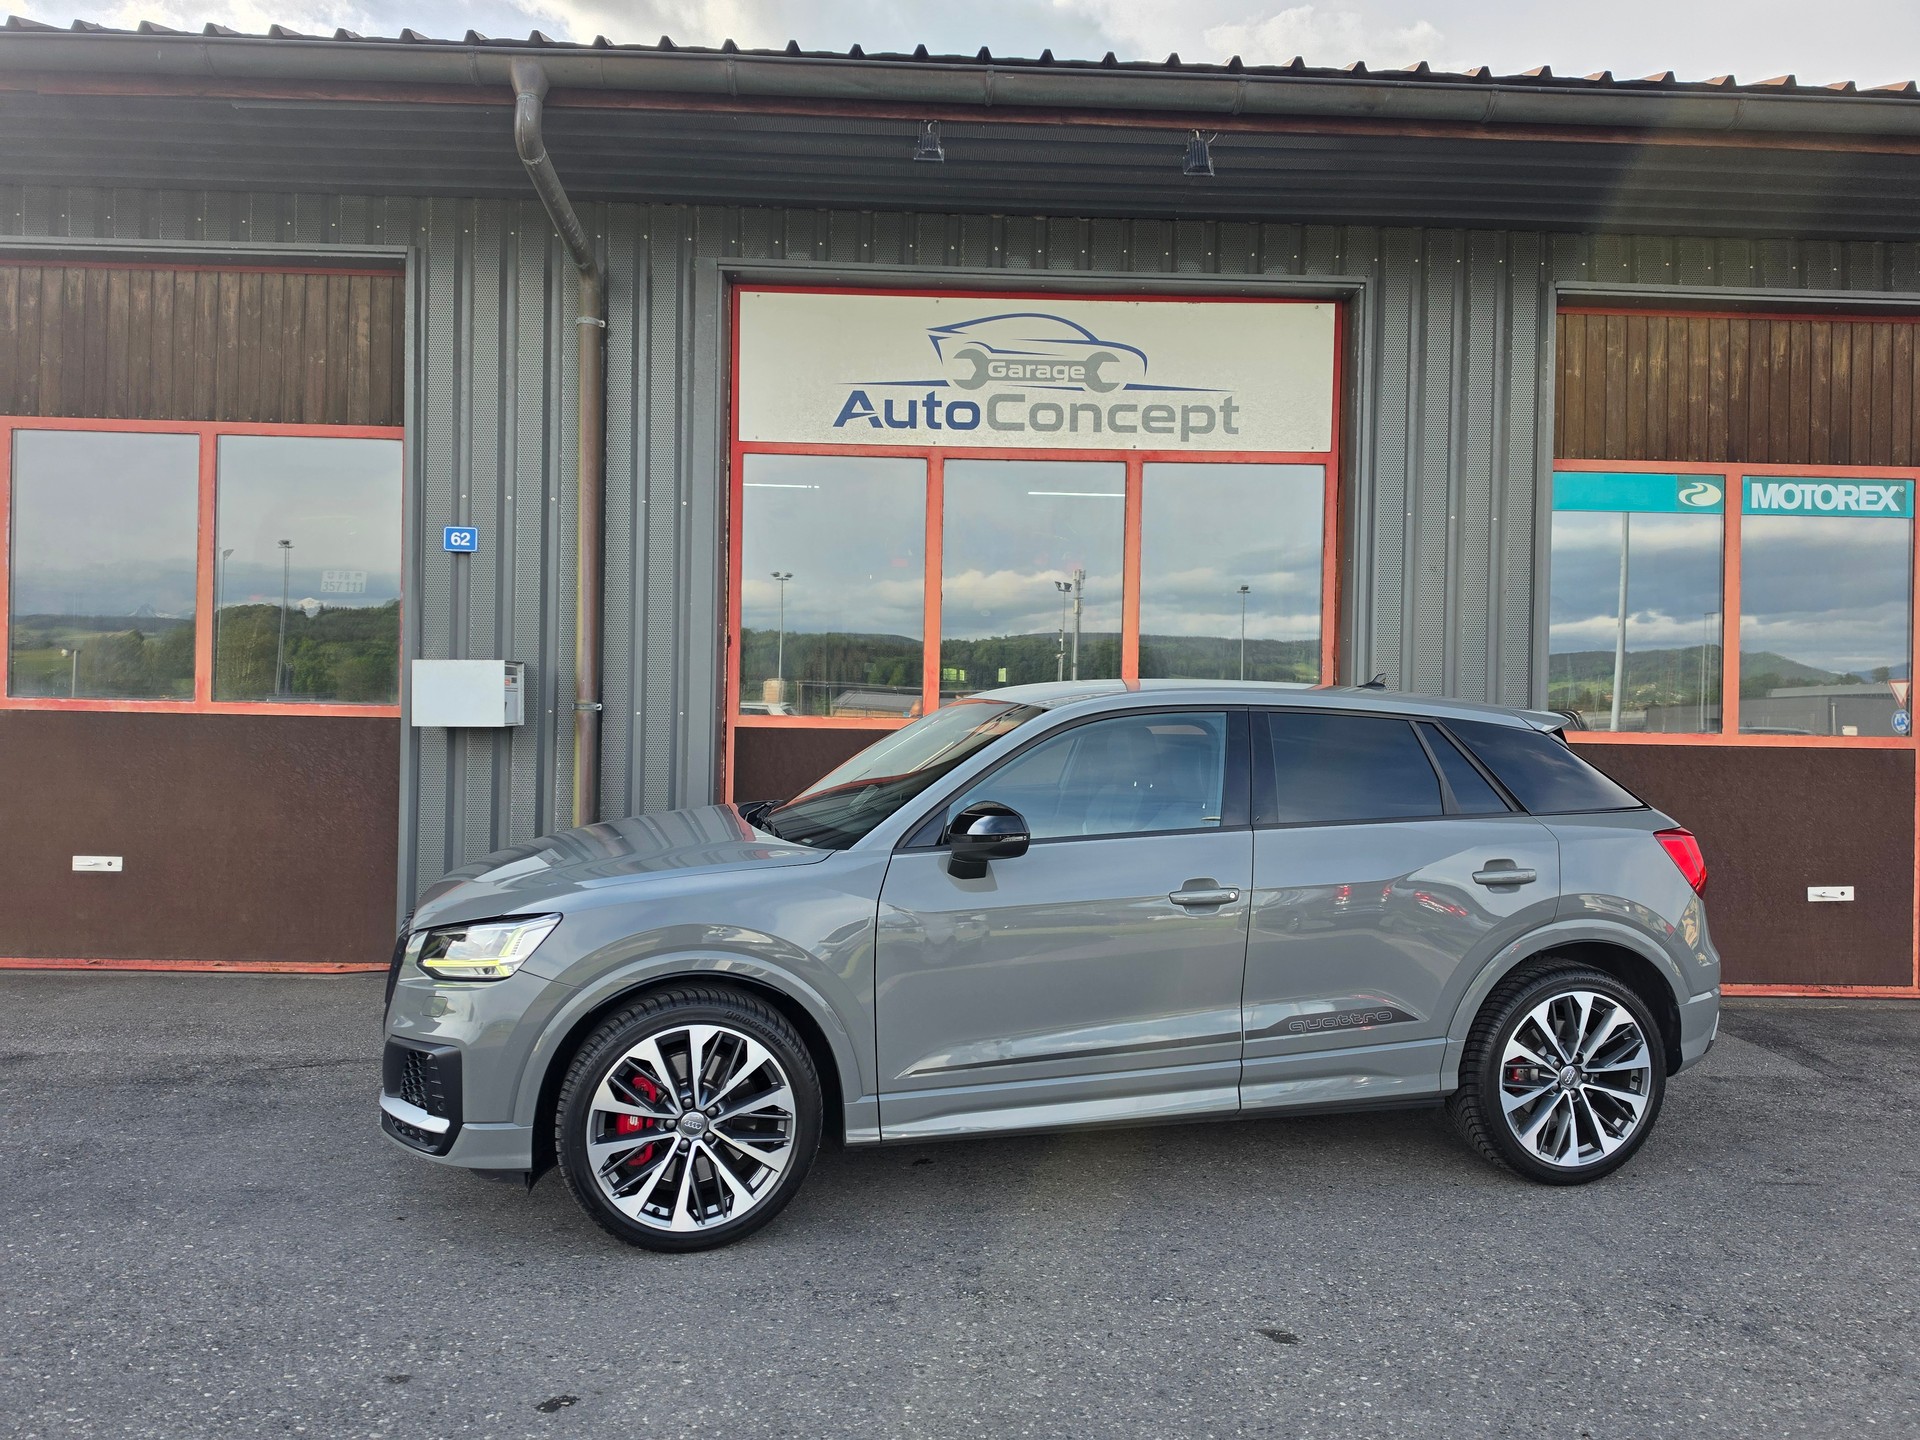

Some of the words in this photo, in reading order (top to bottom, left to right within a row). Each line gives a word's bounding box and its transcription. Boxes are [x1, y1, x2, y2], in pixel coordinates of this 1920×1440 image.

[987, 361, 1086, 383] Garage
[832, 390, 1240, 442] AutoConcept
[450, 532, 470, 546] 62
[723, 1010, 787, 1049] BRIDGESTONE
[1289, 1010, 1393, 1032] quattro
